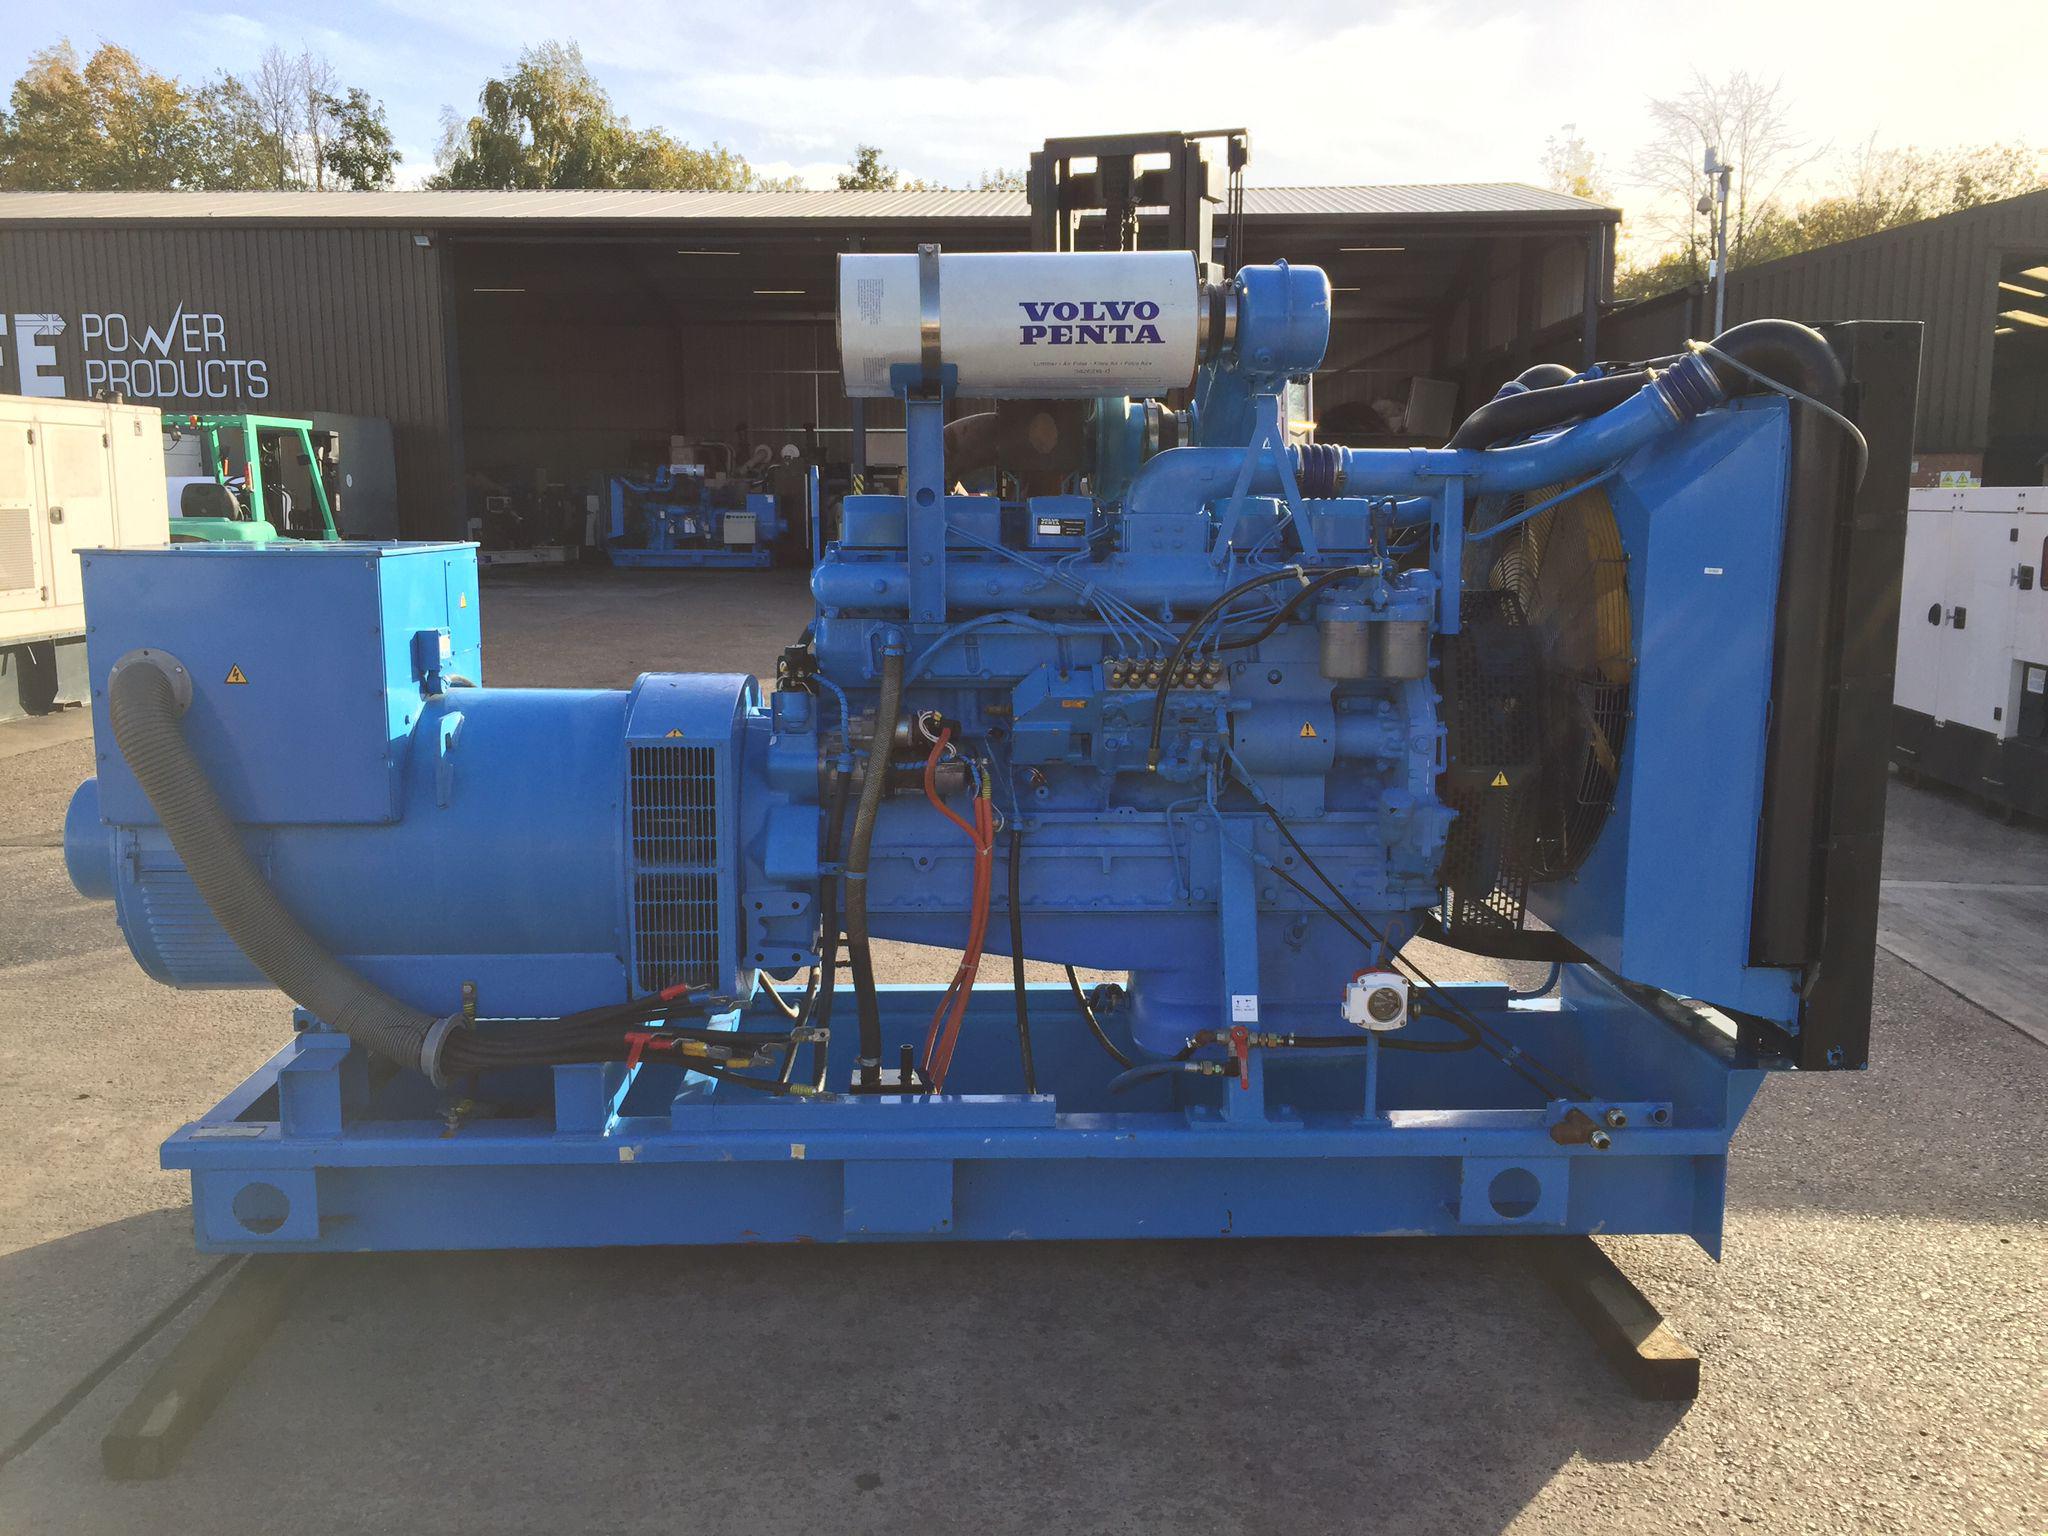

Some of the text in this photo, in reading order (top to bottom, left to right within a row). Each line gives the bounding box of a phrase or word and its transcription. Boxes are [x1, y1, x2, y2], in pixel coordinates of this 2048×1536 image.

[81, 300, 226, 357] POWER
[1019, 301, 1160, 321] VOLVO
[1019, 324, 1165, 345] PENTA
[0, 314, 67, 397] E
[85, 360, 269, 398] PRODUCTS
